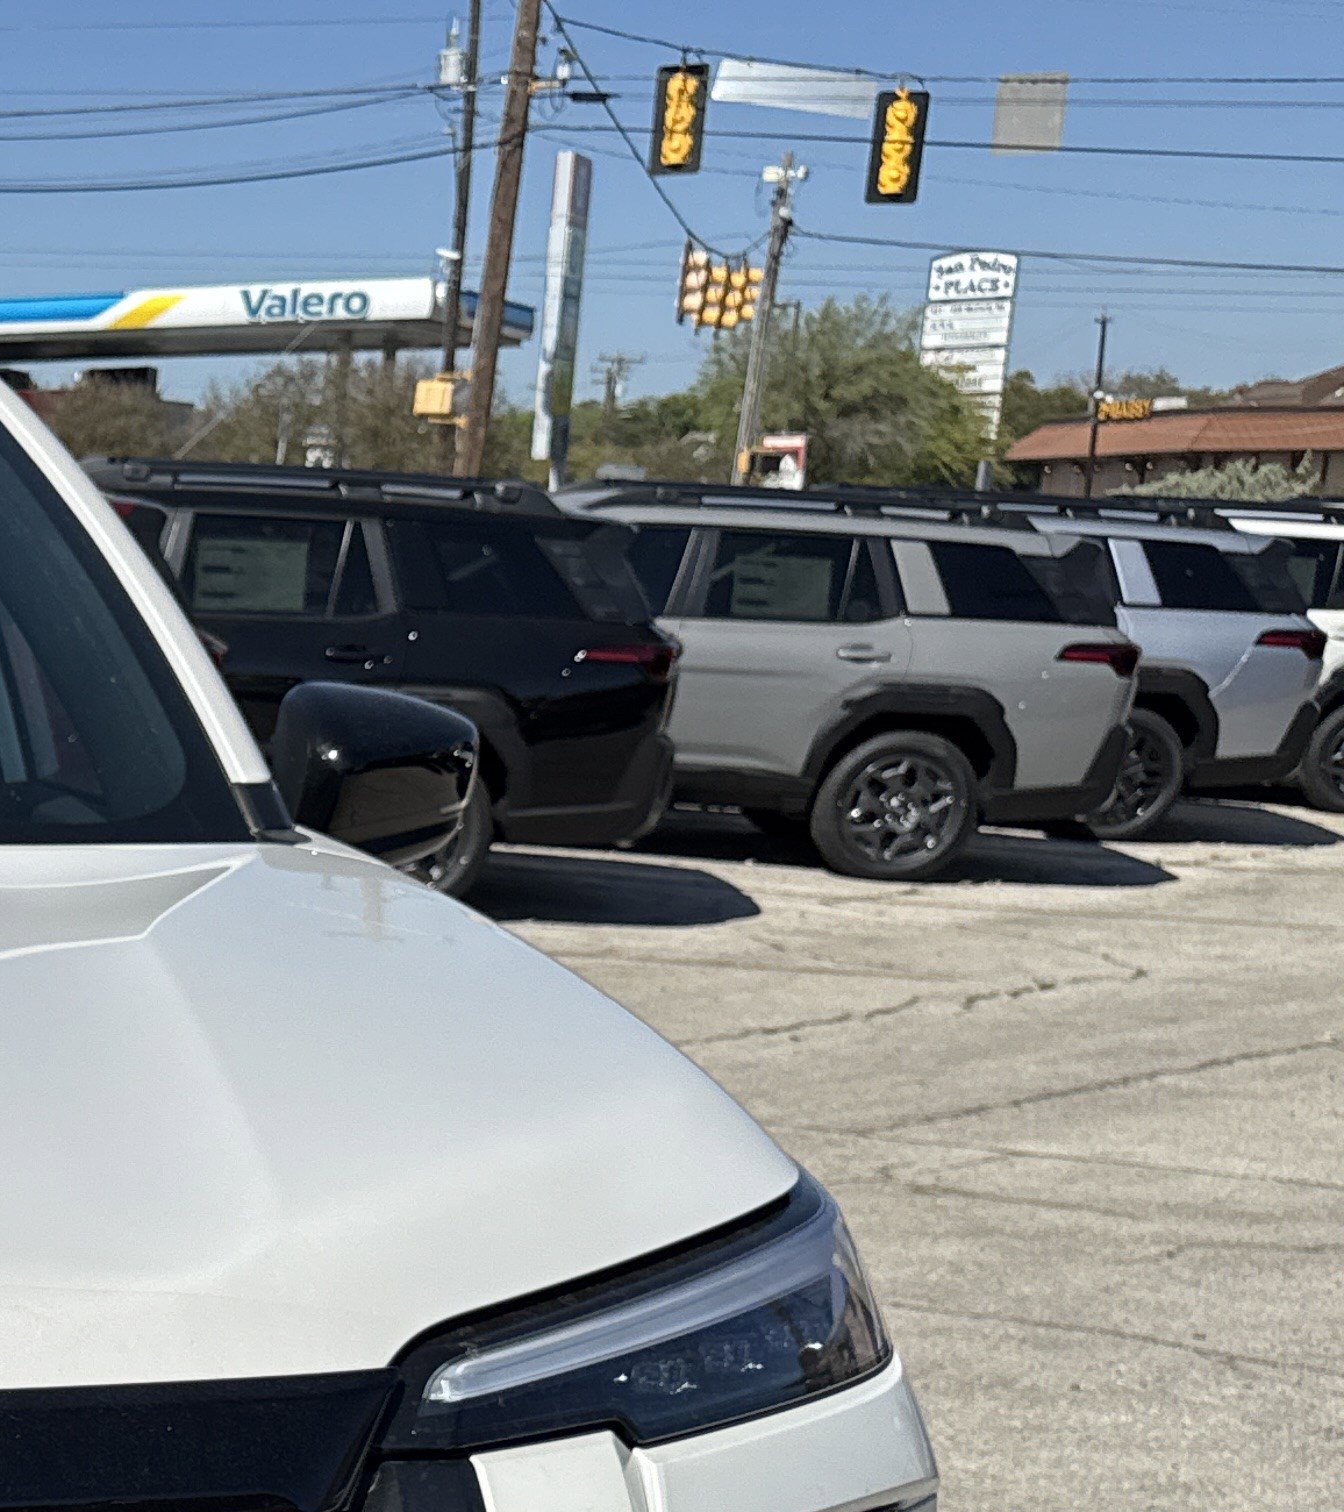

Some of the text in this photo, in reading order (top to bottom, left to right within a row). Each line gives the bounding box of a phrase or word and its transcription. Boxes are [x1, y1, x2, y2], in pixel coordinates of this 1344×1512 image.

[968, 253, 1013, 276] Pedro
[943, 277, 1001, 296] PLACE
[240, 287, 370, 318] Valero
